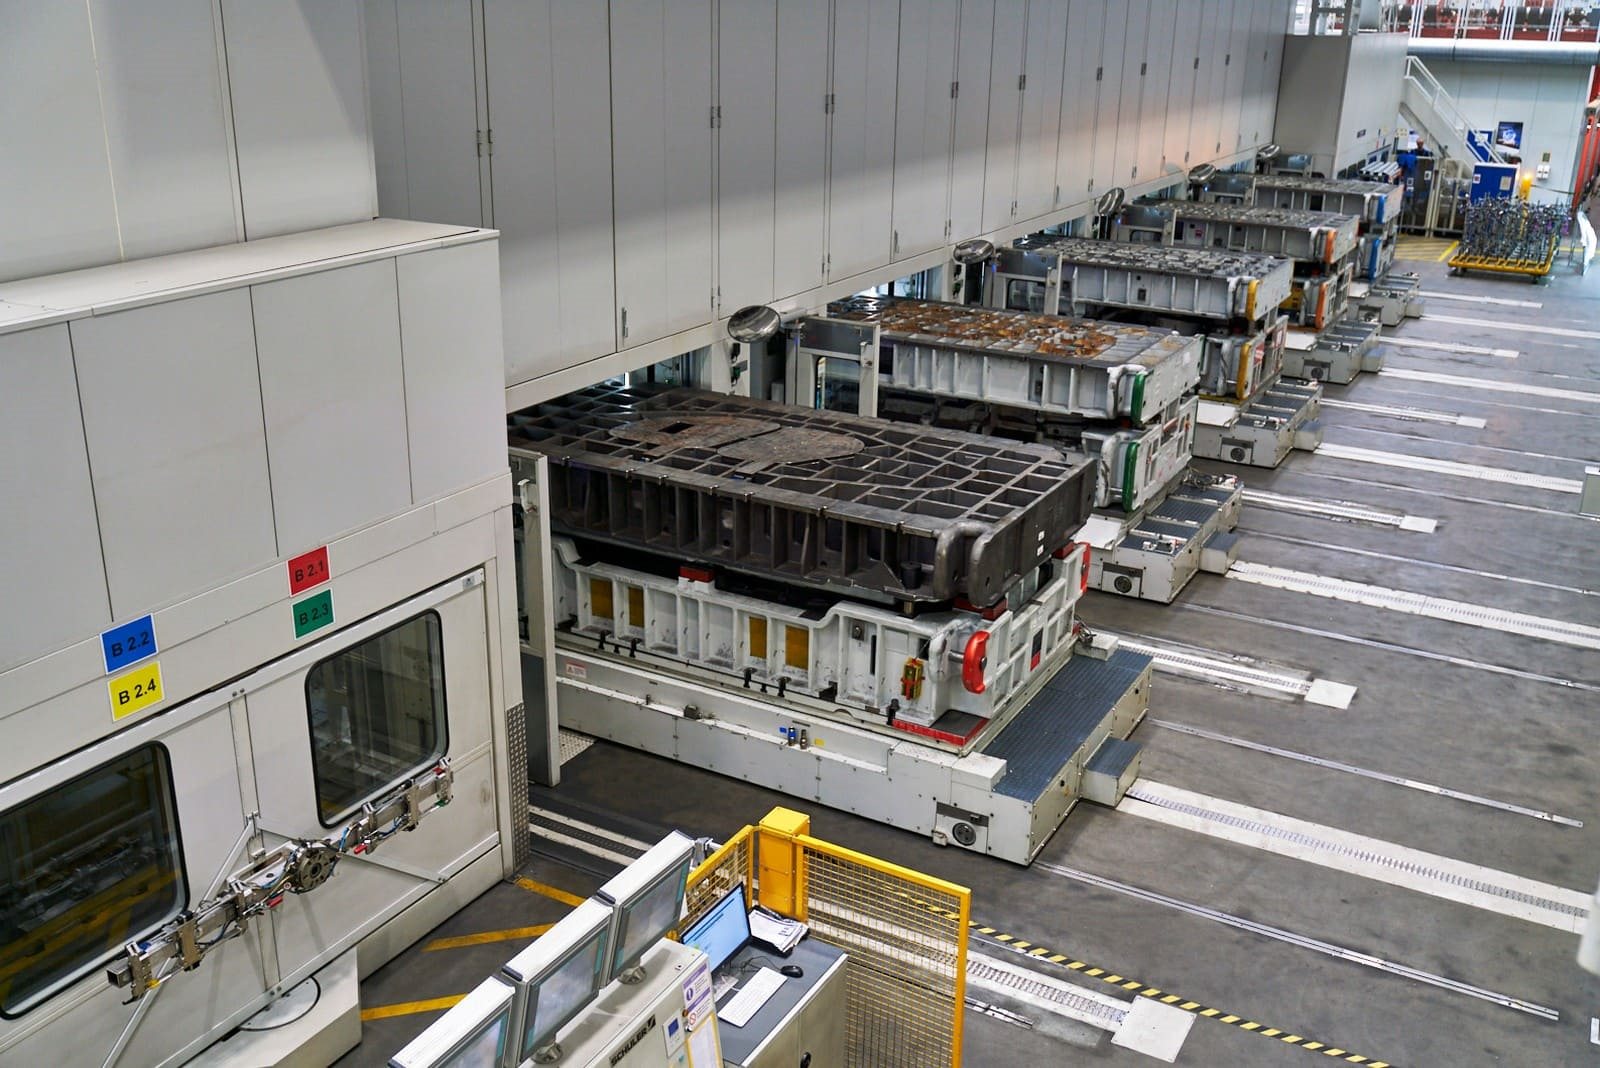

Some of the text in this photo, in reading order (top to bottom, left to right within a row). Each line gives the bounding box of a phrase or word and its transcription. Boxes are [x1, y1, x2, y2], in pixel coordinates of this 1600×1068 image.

[294, 559, 324, 582] B 2.1
[299, 602, 329, 625] B 2.3
[111, 631, 150, 657] B 2.2
[119, 678, 157, 705] B 2.4
[610, 1026, 647, 1067] SCHULER
